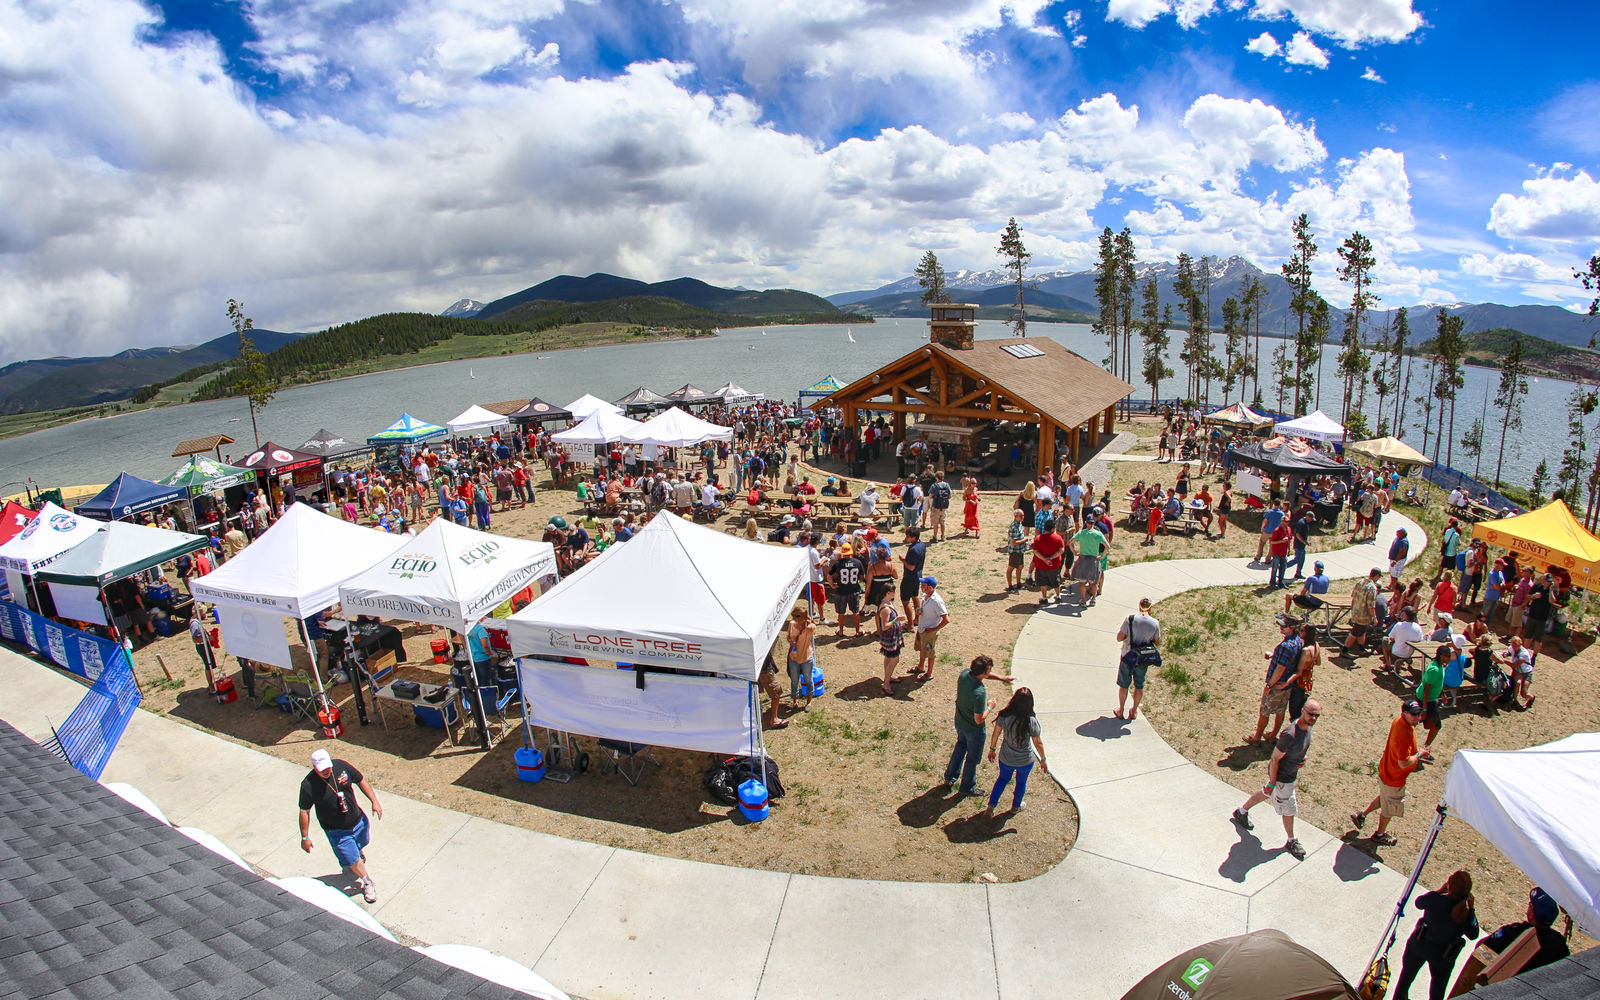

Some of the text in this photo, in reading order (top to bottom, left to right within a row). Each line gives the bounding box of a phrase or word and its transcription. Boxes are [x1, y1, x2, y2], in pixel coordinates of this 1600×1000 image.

[573, 443, 593, 453] FATE
[458, 540, 500, 565] ECHO
[390, 557, 437, 573] ECHO
[840, 568, 859, 585] 88
[205, 589, 223, 598] MUTUAL
[223, 592, 241, 600] FRIEND
[241, 594, 255, 603] MALT
[261, 597, 277, 606] BREW
[466, 590, 495, 615] ECHO
[496, 564, 536, 596] BREWING
[346, 596, 456, 619] ECHO BREWING CO.
[573, 633, 702, 655] LONE TREE
[574, 644, 634, 655] BREWING
[638, 650, 703, 661] COMPANY
